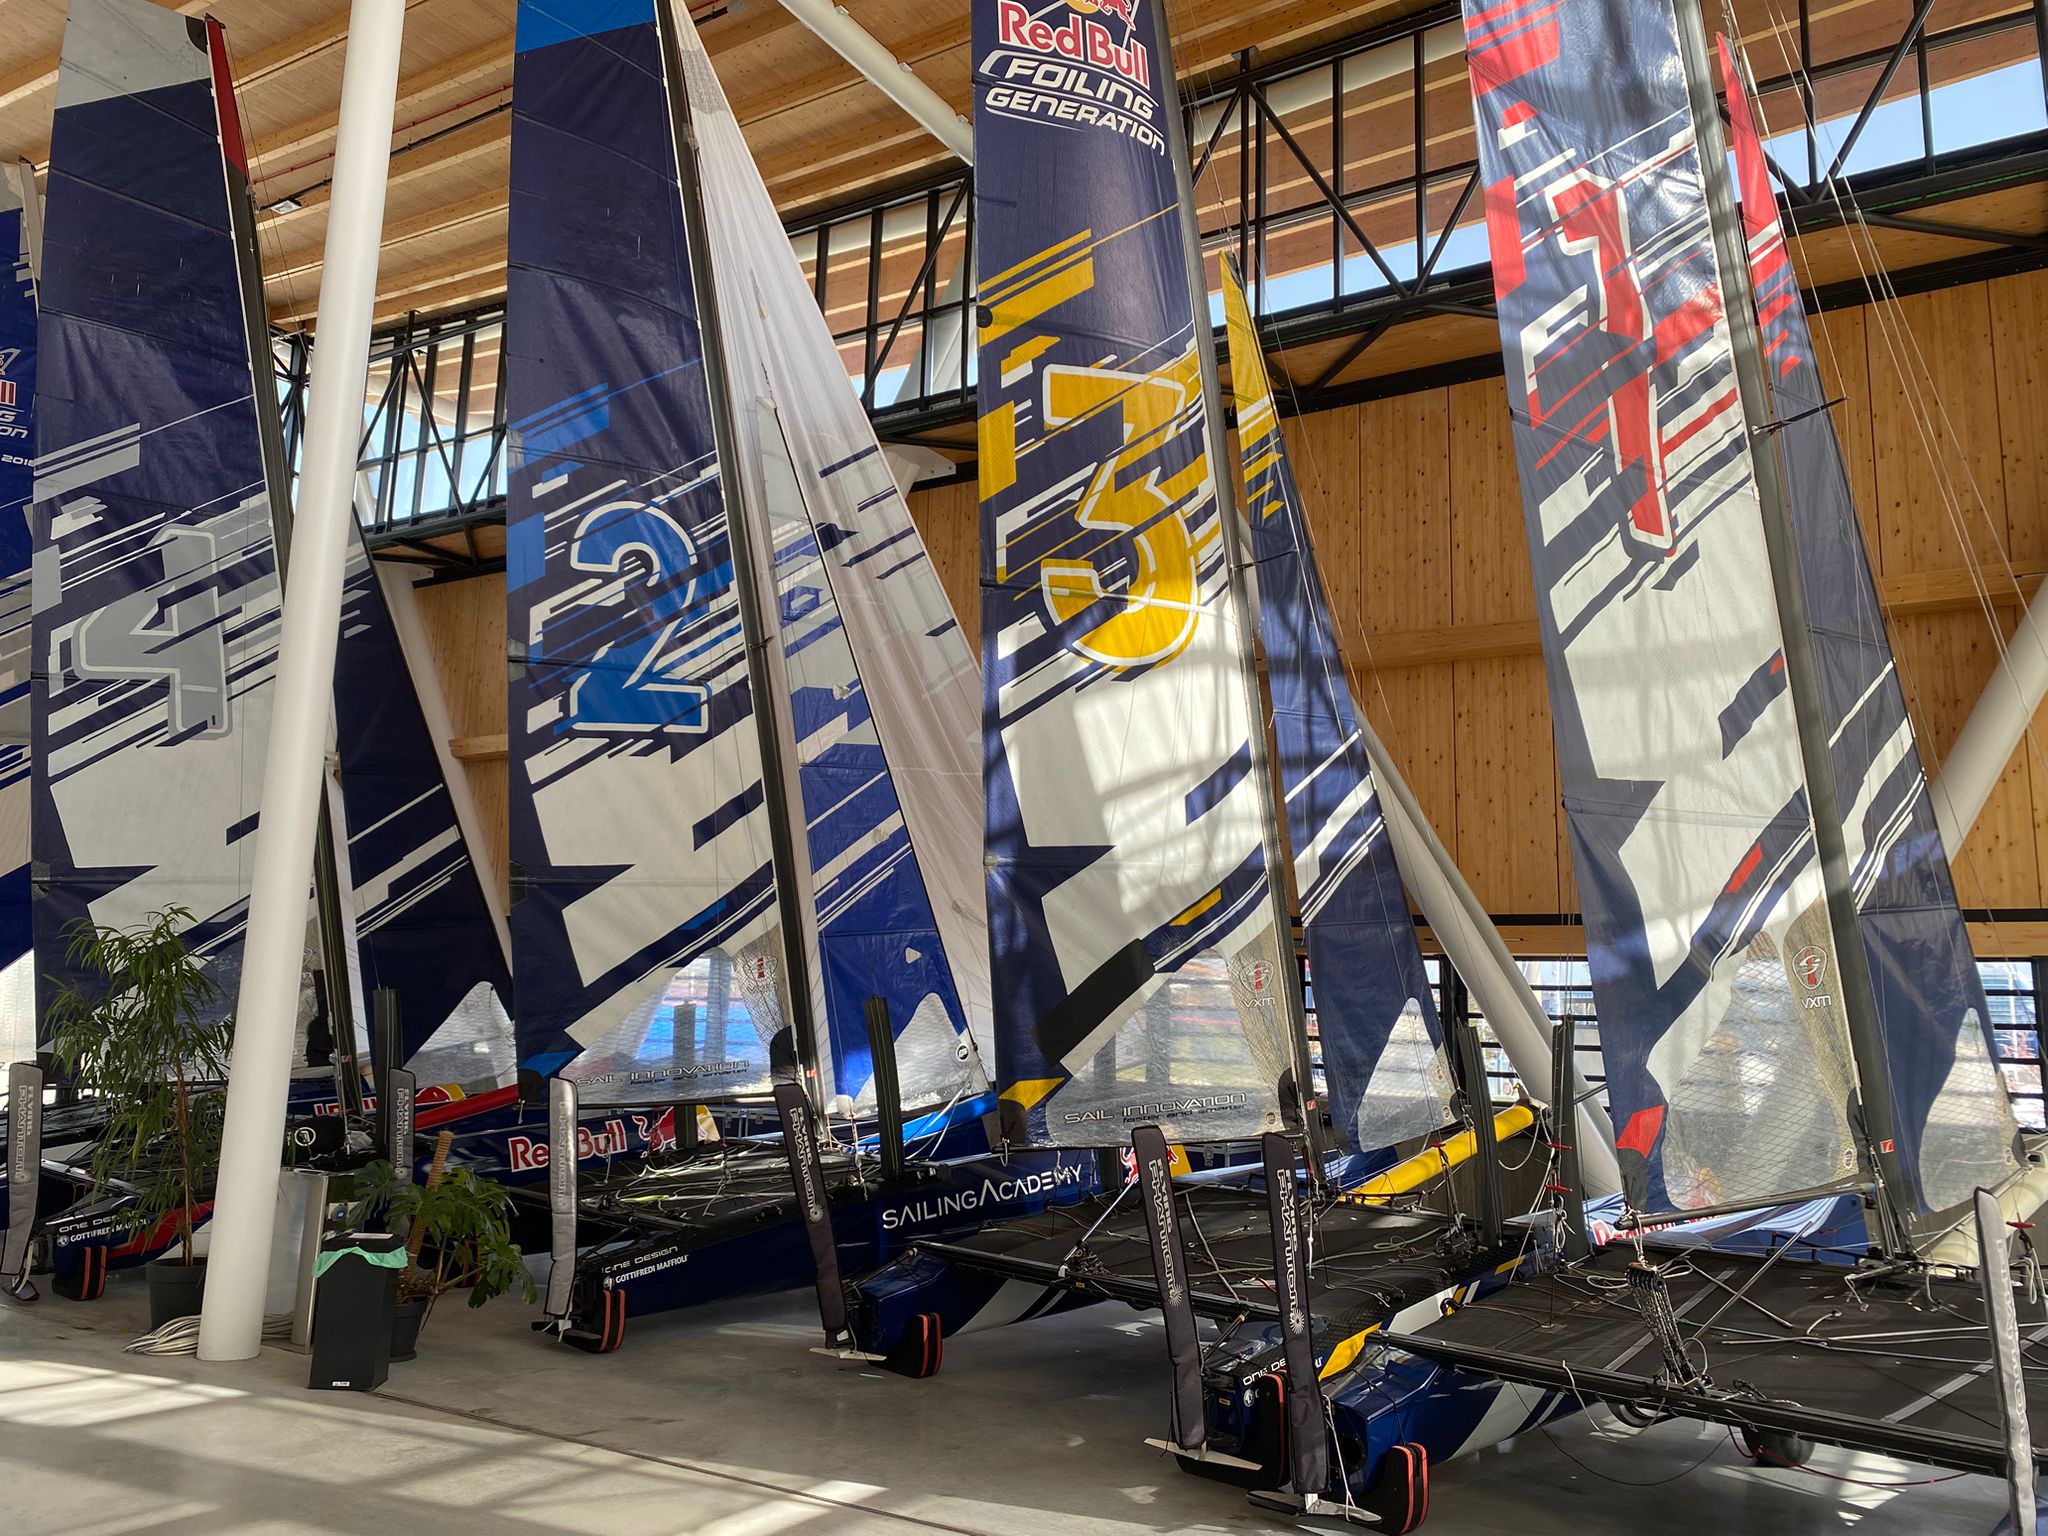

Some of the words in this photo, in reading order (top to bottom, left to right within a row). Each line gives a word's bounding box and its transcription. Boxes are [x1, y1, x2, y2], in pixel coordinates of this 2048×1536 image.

[998, 0, 1084, 61] Red
[1085, 19, 1151, 91] Bull
[1005, 58, 1154, 120] FOILING
[985, 86, 1165, 157] GENERATION
[1041, 363, 1198, 668] 3
[570, 500, 711, 734] 2
[1064, 1110, 1114, 1124] SAIL
[1122, 1092, 1247, 1117] INNOVATION
[508, 1136, 549, 1173] Re
[615, 1265, 656, 1284] GOTTIFREDI
[634, 1245, 678, 1264] DESIGN
